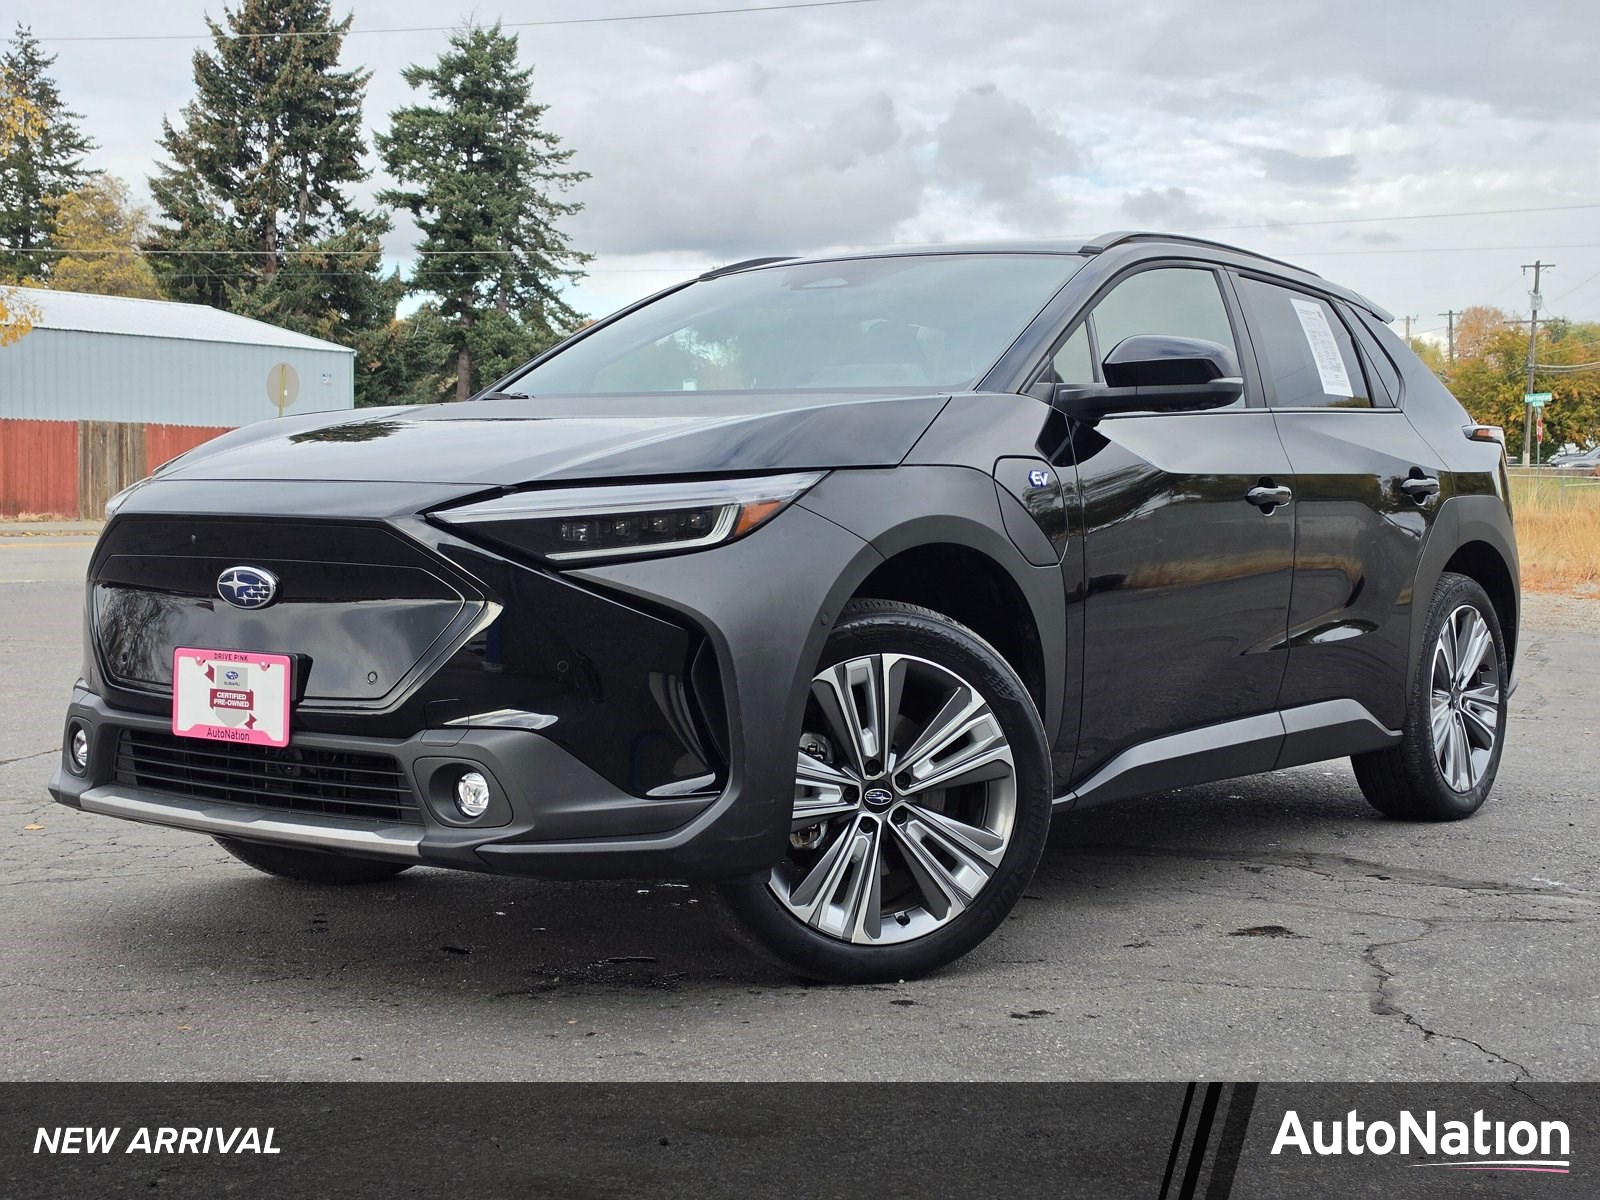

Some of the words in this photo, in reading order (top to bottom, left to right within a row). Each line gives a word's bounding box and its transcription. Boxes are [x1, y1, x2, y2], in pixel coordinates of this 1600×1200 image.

[1030, 470, 1049, 486] EV
[213, 653, 232, 661] DRIVE
[234, 654, 249, 662] PINK
[216, 692, 247, 701] CERTIFIED
[213, 699, 250, 708] PRE-OWNED
[207, 728, 250, 741] AutoNation
